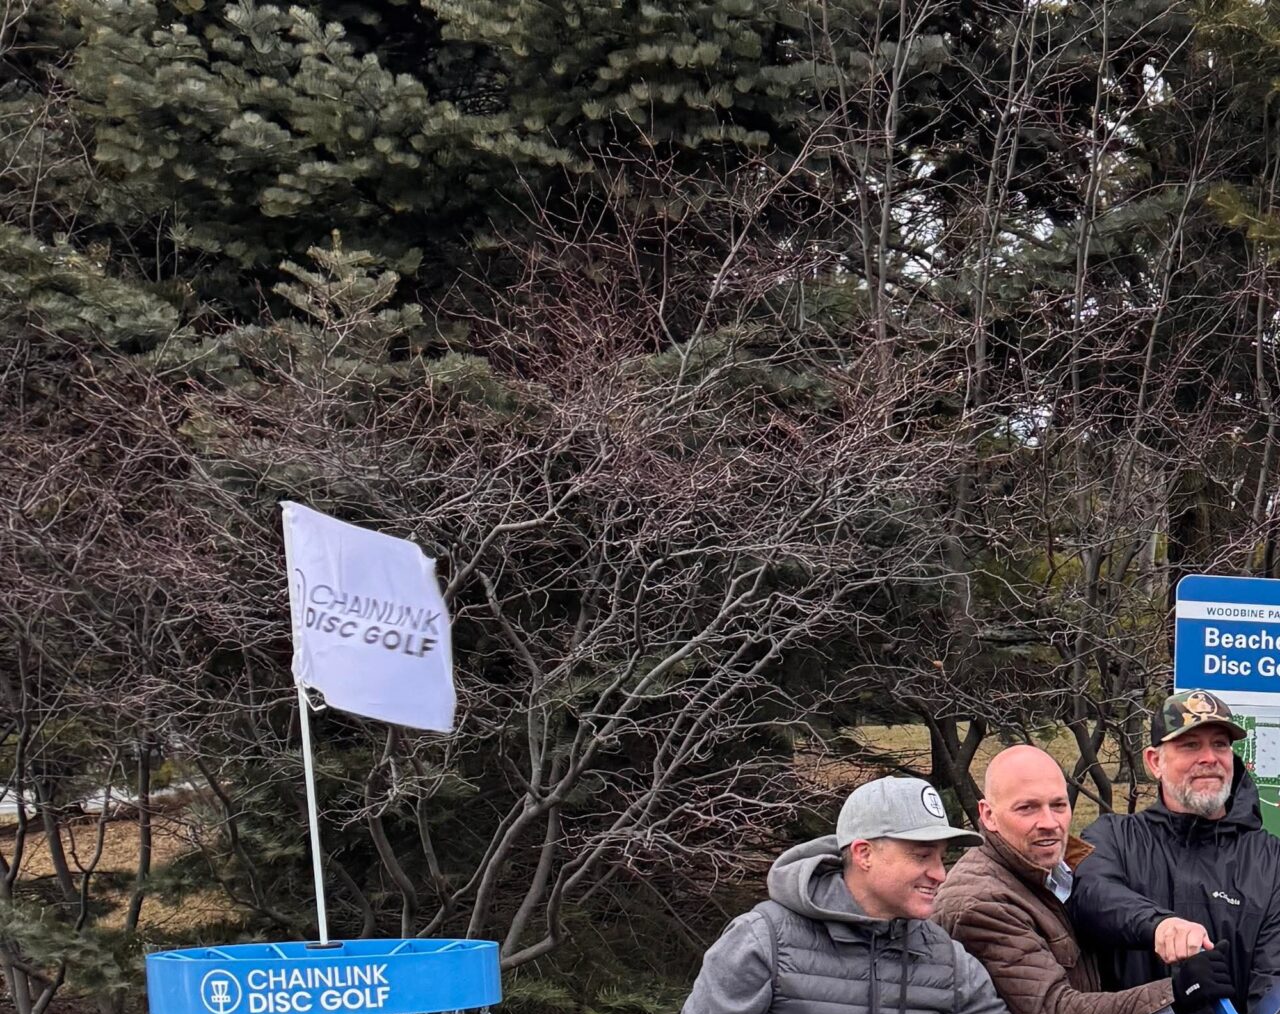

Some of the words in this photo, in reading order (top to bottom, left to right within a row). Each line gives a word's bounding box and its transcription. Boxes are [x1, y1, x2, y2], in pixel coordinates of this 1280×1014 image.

[309, 584, 441, 636] CHAINLINK
[1206, 606, 1265, 619] WOODBINE
[306, 607, 358, 638] DISC
[363, 626, 439, 658] GOLF
[1203, 654, 1251, 676] Disc
[247, 963, 389, 991] CHAINLINK
[249, 991, 313, 1014] DISC
[320, 987, 390, 1011] GOLF
